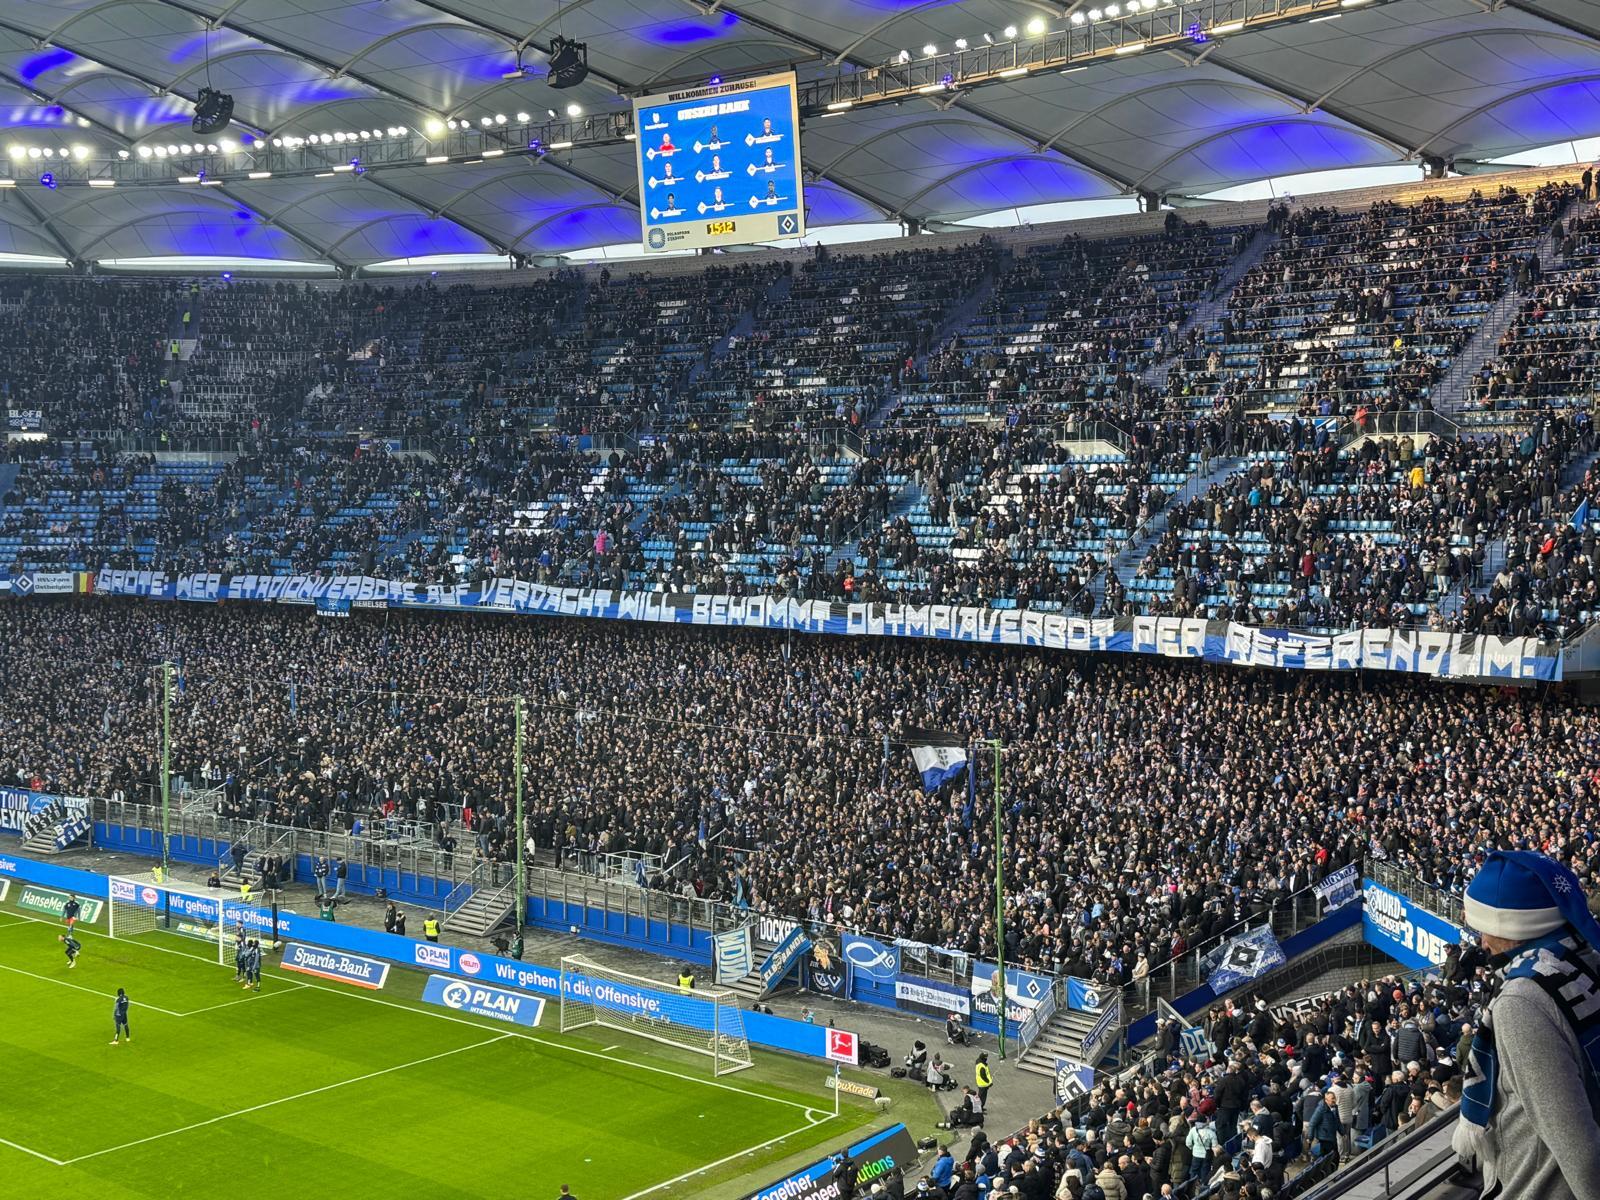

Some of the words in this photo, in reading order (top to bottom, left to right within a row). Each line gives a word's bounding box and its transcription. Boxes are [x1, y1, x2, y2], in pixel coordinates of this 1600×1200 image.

[668, 86, 719, 102] WILLKOMMEN
[719, 80, 757, 93] ZUHAUSE!
[352, 600, 388, 609] DIEMELSEE
[99, 568, 169, 596] GROTE:
[176, 573, 222, 598] WER
[229, 575, 418, 603] STADIONVERBOTE
[424, 583, 471, 605] AUF
[479, 578, 613, 617] VERDACHT
[692, 594, 832, 631] BEKOMMT
[846, 602, 1115, 651] OLYMPIAVERBOT
[1132, 615, 1208, 657] PER
[1225, 621, 1539, 678] REFERENDUM!
[0, 791, 29, 811] TOUR
[120, 885, 134, 894] PLAN
[169, 894, 184, 908] Wir
[185, 900, 214, 915] gehen
[226, 908, 241, 920] die
[242, 911, 290, 931] Offensve:
[294, 947, 371, 979] Sparda-Bank
[429, 949, 448, 961] PLAN
[496, 963, 515, 980] Wir
[518, 970, 557, 990] gehen
[573, 979, 592, 997] die
[595, 986, 660, 1012] Offensive:
[472, 990, 521, 1014] PLAN
[470, 1006, 514, 1022] INTERNATIONAL
[855, 1155, 895, 1186] utions
[752, 1174, 817, 1200] Together,
[799, 1182, 841, 1200] oneer
